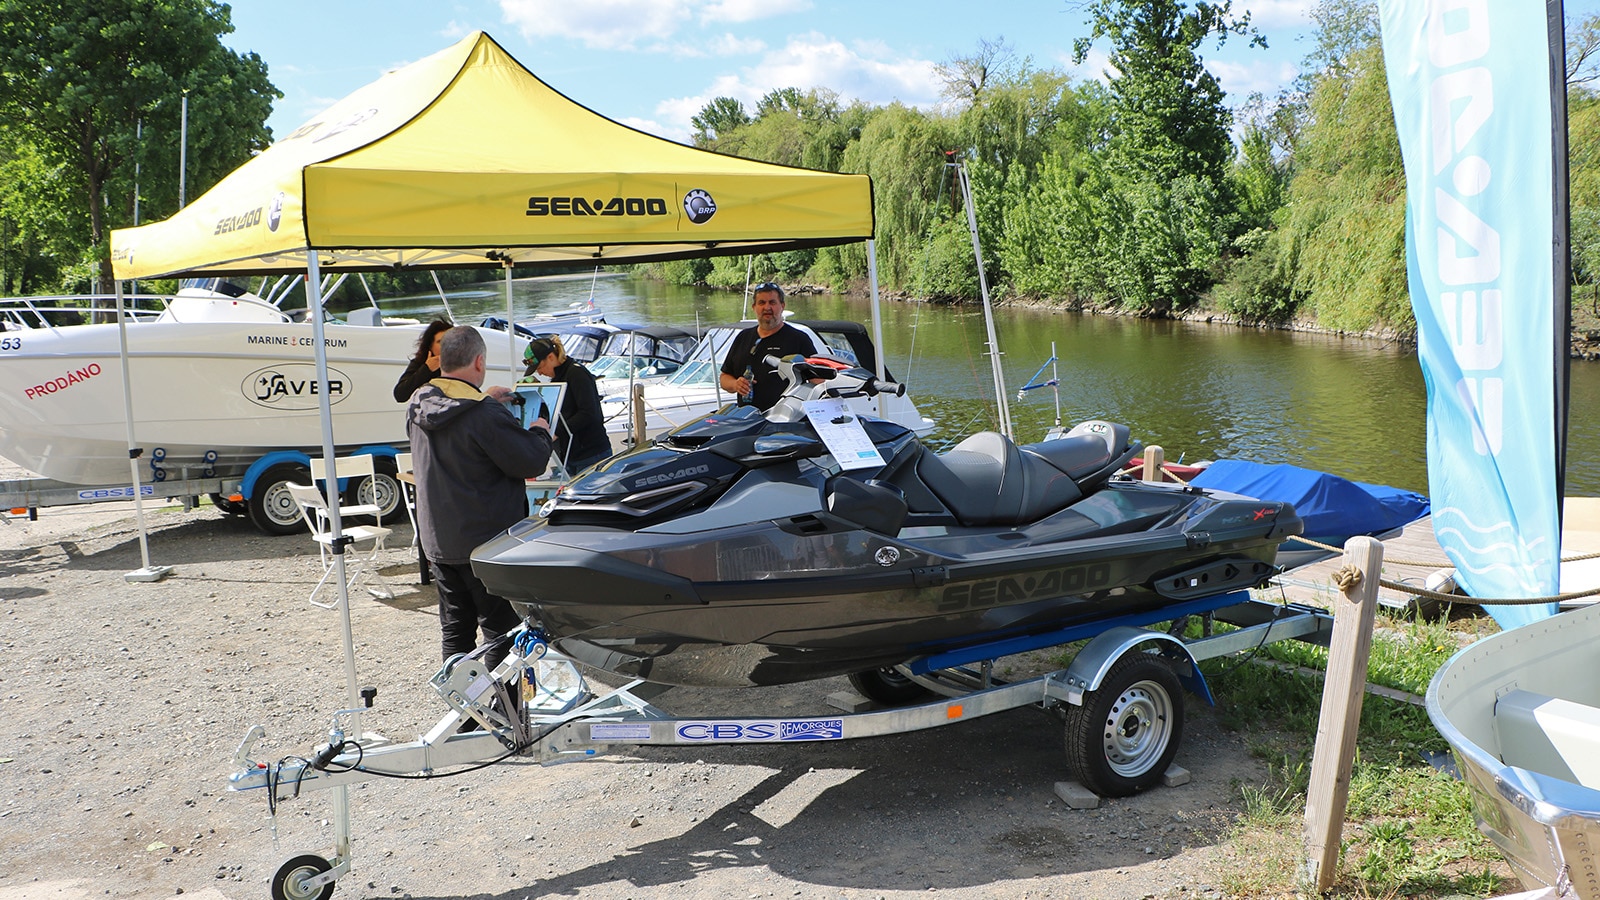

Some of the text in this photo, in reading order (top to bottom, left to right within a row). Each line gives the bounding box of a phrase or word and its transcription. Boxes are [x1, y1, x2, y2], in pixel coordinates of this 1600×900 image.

[247, 335, 347, 348] MARINE CERUM
[24, 363, 102, 400] PRODÁNO
[79, 488, 123, 499] CBS
[677, 720, 843, 740] CBS REMORQUES
